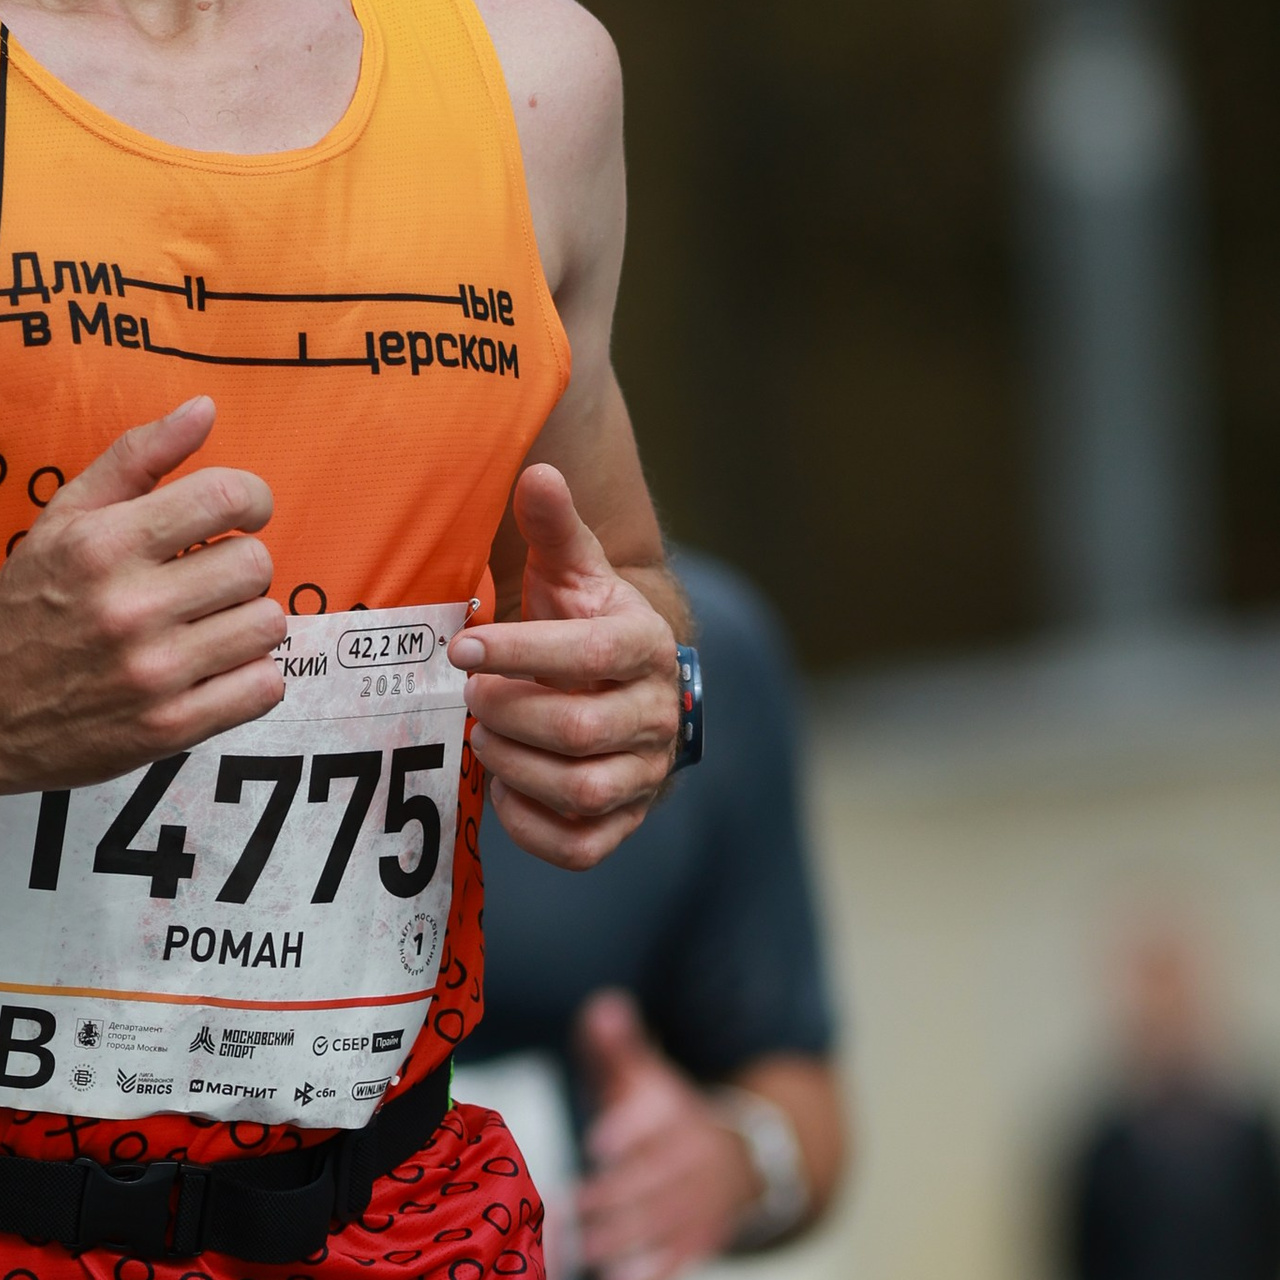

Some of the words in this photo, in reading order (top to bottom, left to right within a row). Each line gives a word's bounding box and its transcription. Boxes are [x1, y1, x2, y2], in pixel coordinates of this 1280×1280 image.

[22, 310, 51, 347] в
[348, 635, 390, 661] 42,2
[397, 632, 424, 655] КМ
[360, 672, 416, 697] 2026
[27, 743, 445, 904] 14775
[163, 926, 304, 969] РОМАН
[413, 932, 424, 956] 1
[108, 1022, 163, 1033] Департамент
[107, 1032, 136, 1041] спорта
[222, 1028, 295, 1046] МОСКОВСКИЙ
[332, 1037, 370, 1052] СБЕР
[106, 1042, 135, 1051] города
[137, 1043, 168, 1052] Москвы
[219, 1043, 256, 1059] СПОРТ
[136, 1084, 173, 1095] BRICS
[315, 1088, 337, 1098] сбп
[355, 1082, 388, 1097] WINLINE
